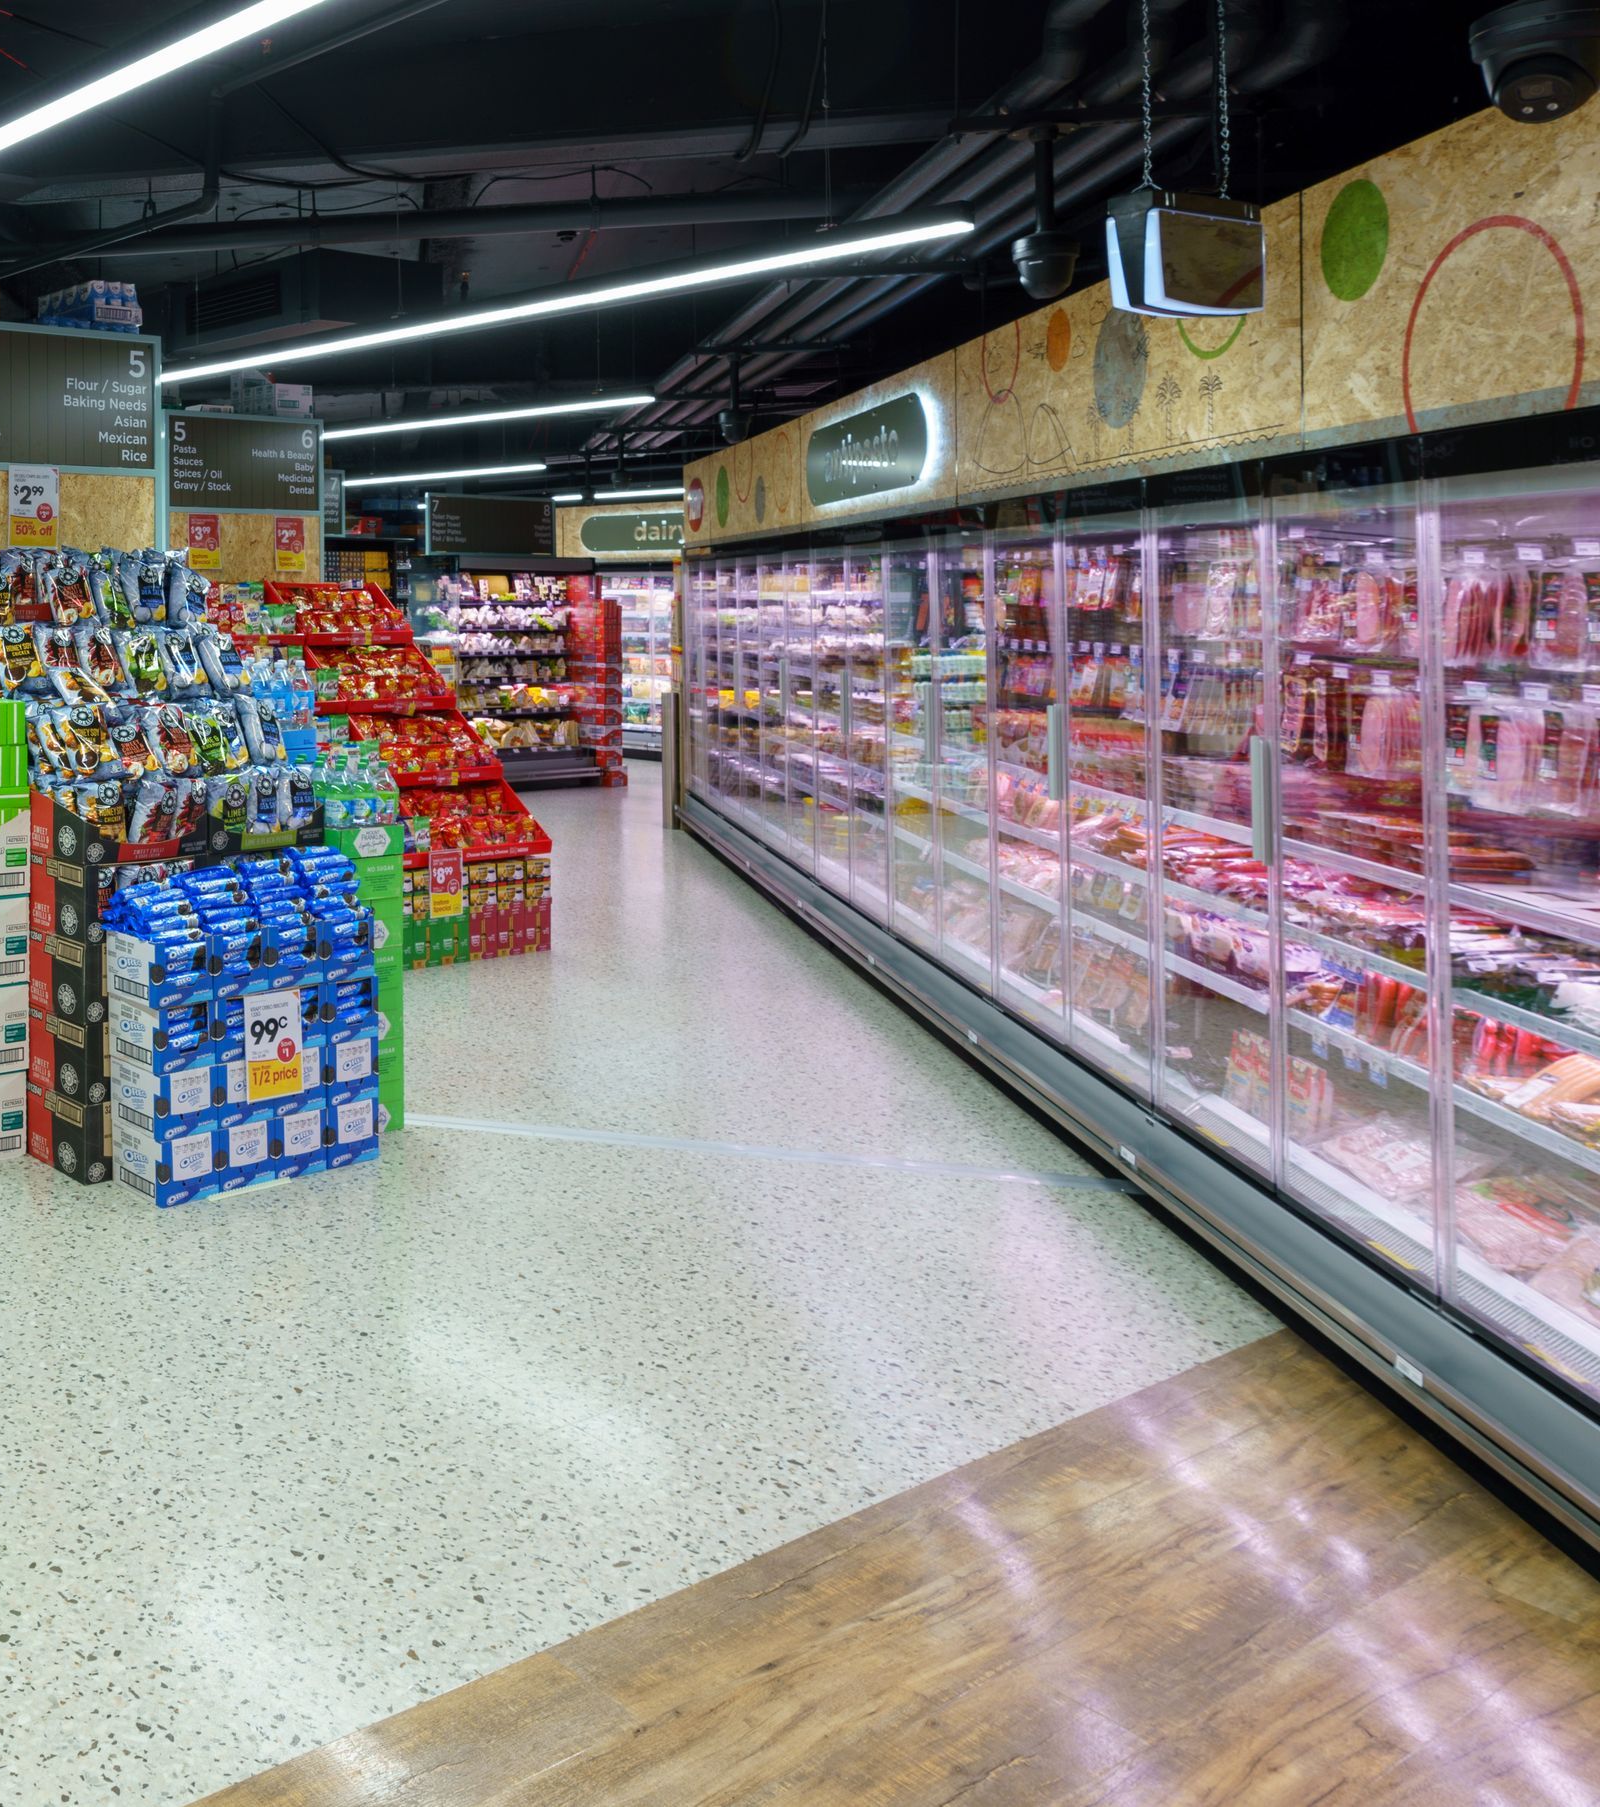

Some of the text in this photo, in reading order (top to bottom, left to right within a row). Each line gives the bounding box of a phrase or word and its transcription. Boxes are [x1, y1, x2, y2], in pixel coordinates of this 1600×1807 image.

[128, 350, 145, 378] 5
[66, 377, 98, 392] Flour
[112, 381, 147, 396] Sugar
[64, 394, 147, 412] Baking Needs
[114, 416, 147, 429] Asian
[174, 421, 186, 442] 5
[98, 432, 147, 446] Mexican
[301, 429, 313, 449] 6
[173, 444, 197, 454] Pasta
[252, 449, 278, 459] Health
[287, 451, 314, 461] Beauty
[121, 449, 147, 463] Rice
[173, 456, 203, 466] Sauces
[173, 468, 201, 479] Spices
[210, 470, 223, 479] Oil
[295, 463, 314, 473] Baby
[278, 473, 314, 483] Medicinal
[173, 481, 199, 492] Gravy
[207, 482, 232, 492] Stock
[289, 486, 314, 495] Dental
[432, 500, 439, 512] 7
[544, 504, 551, 516] 8
[15, 525, 53, 536] 50% off
[273, 1066, 298, 1085] price
